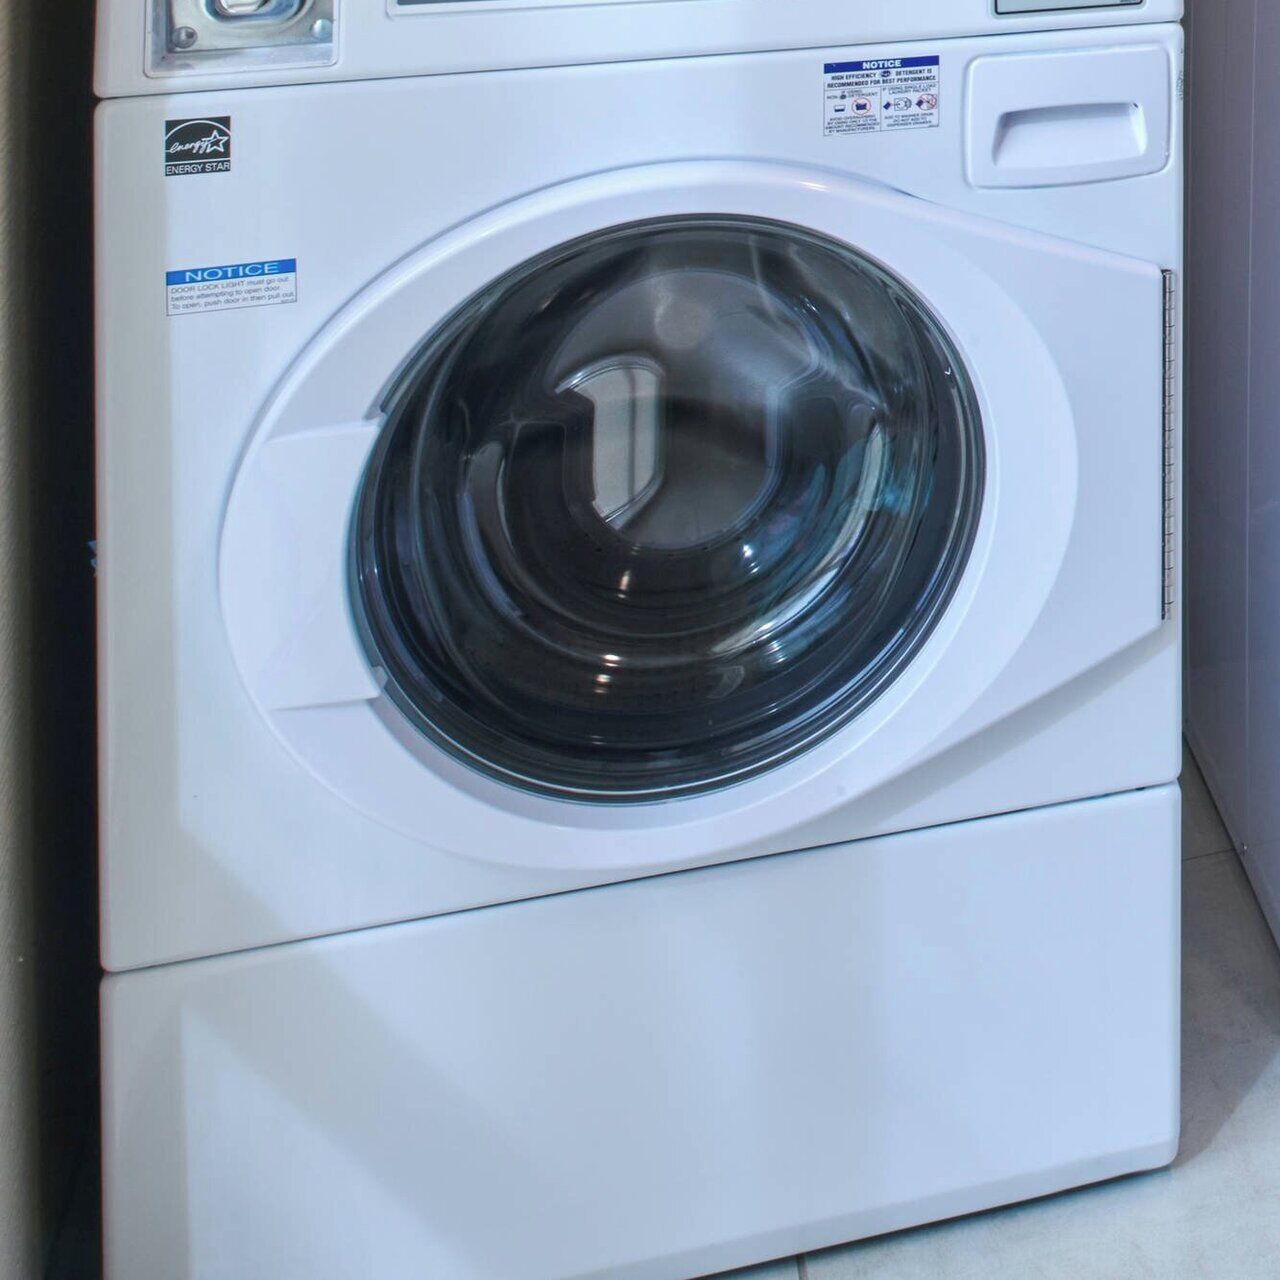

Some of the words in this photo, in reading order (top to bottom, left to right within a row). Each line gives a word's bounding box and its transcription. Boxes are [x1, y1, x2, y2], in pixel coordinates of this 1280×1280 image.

[862, 59, 902, 69] NOTICE
[845, 72, 876, 80] EFFICIENCY
[895, 68, 925, 76] DETERGENT
[827, 80, 869, 88] RECOMMENDED
[896, 75, 936, 83] PERFORMANCE
[166, 163, 203, 175] ENERGY
[205, 161, 230, 172] STAR
[185, 262, 279, 281] NOTICE
